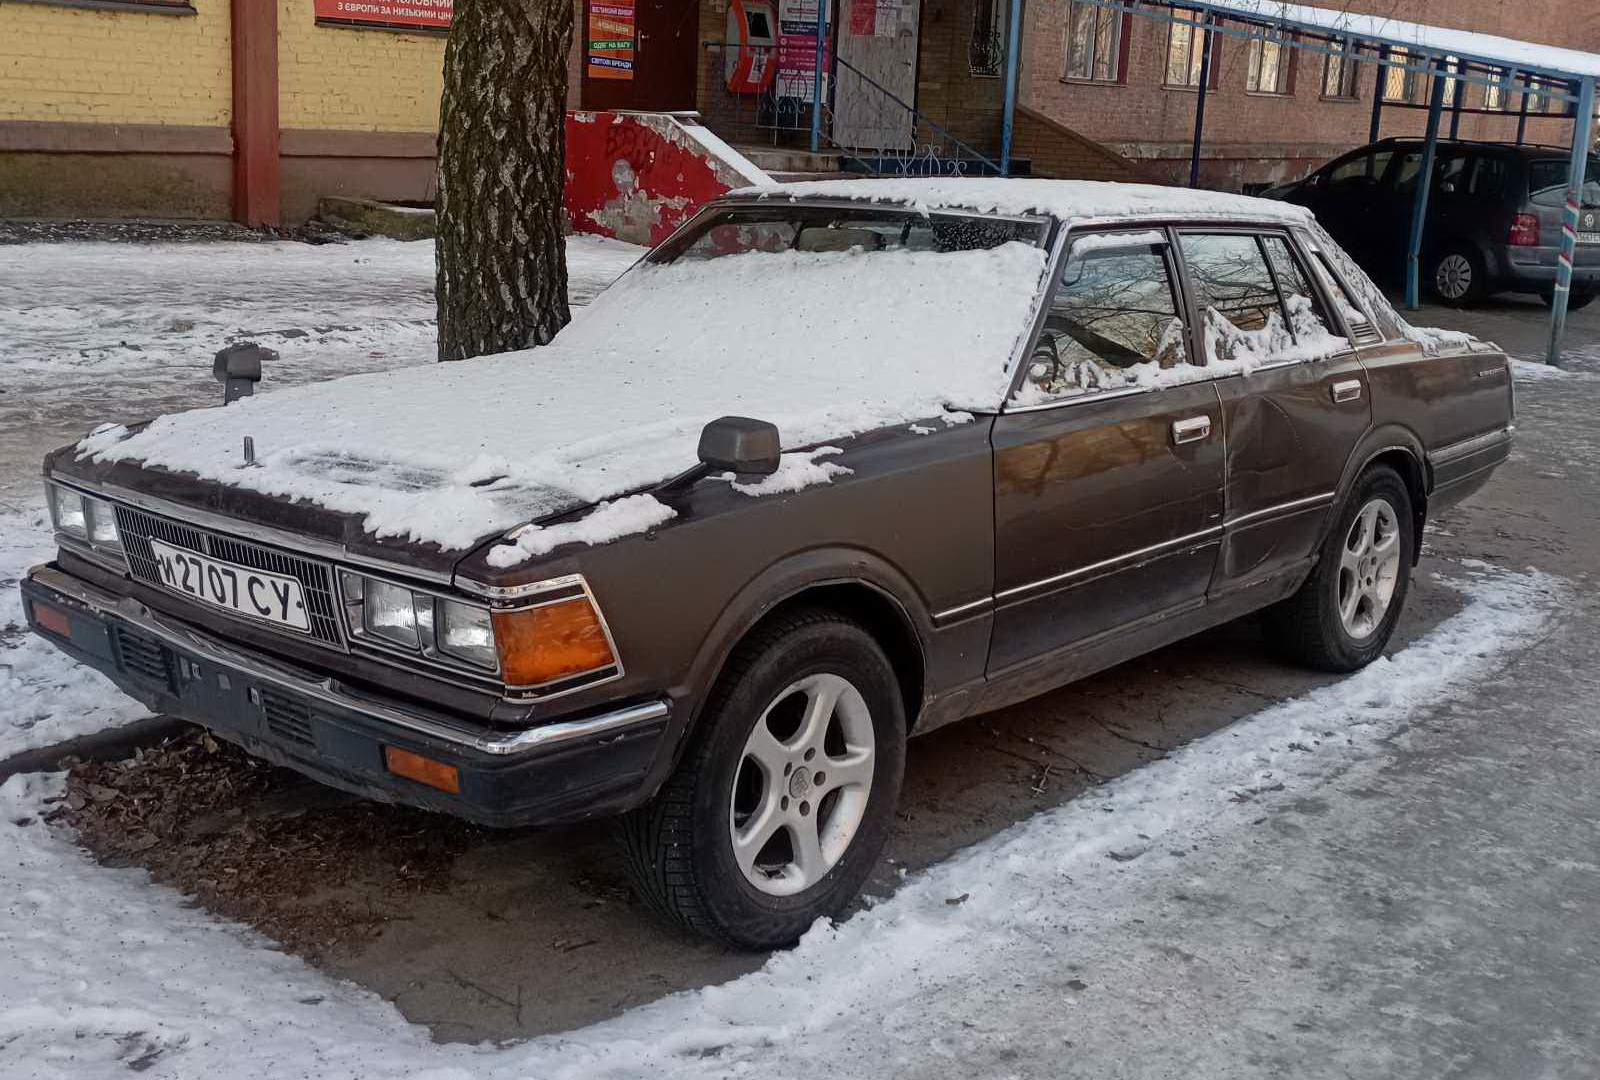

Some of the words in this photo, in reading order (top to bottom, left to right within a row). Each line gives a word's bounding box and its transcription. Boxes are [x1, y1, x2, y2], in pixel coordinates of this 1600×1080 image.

[345, 3, 379, 13] ЄВРОПИ
[381, 6, 391, 14] ЗА
[393, 7, 436, 18] НИЗЬКИМИ
[247, 575, 290, 621] СУ
